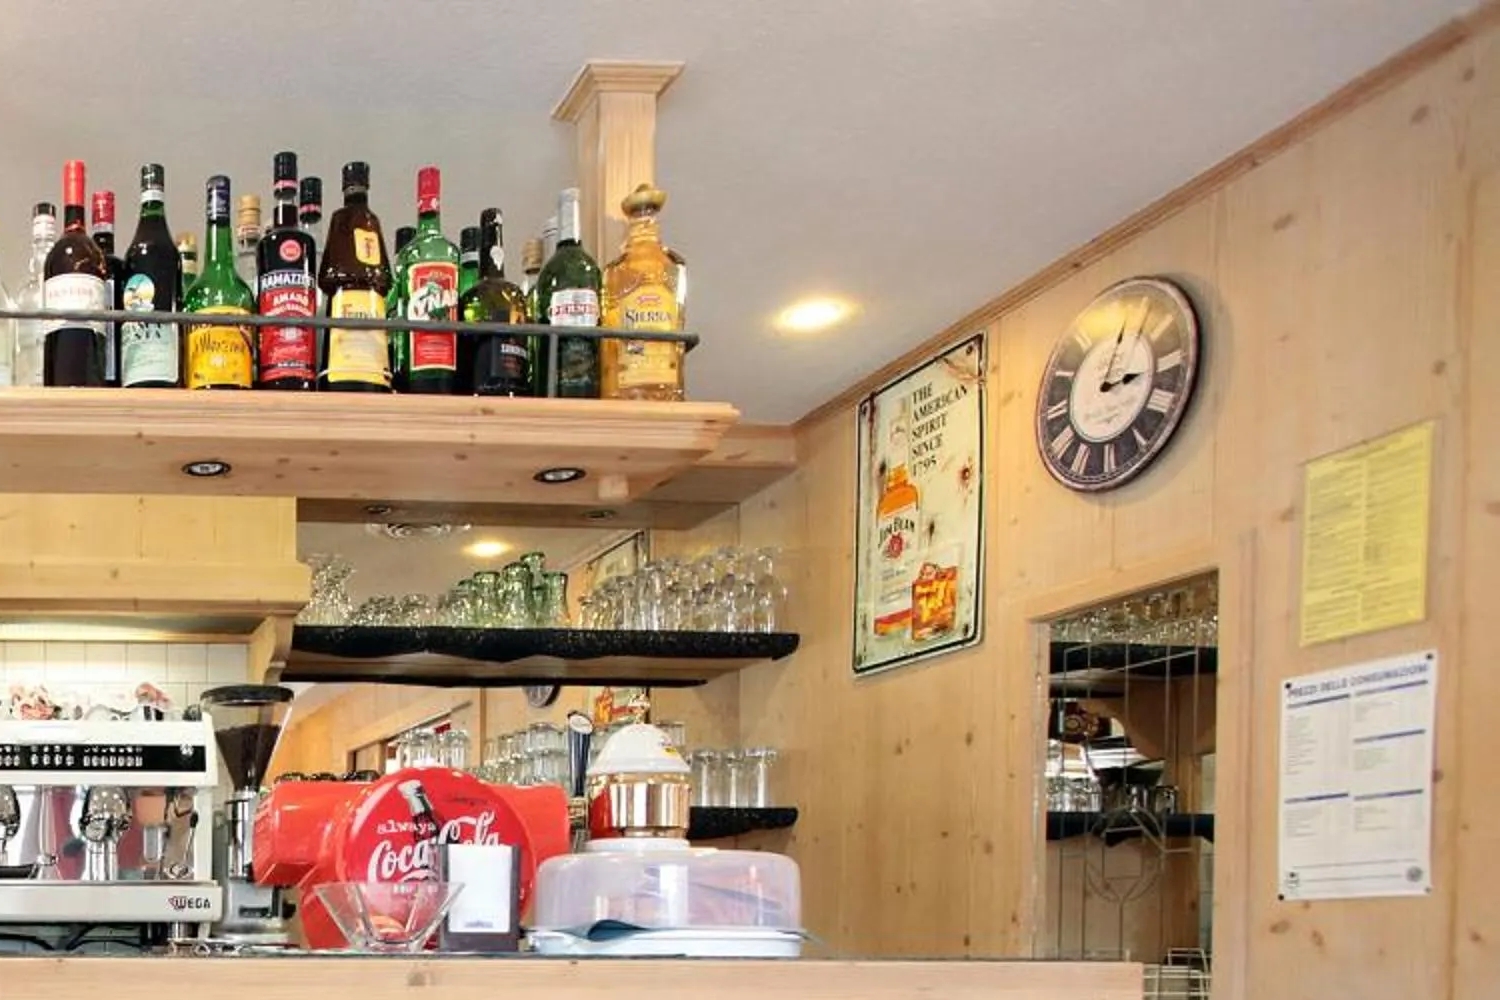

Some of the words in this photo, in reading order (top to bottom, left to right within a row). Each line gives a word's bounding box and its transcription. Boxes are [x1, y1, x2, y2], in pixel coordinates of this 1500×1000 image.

[912, 382, 933, 404] THE
[913, 384, 968, 421] AMERICAN
[912, 412, 947, 438] SPIRIT
[912, 432, 942, 456] SINCE
[377, 819, 437, 835] always
[173, 898, 211, 909] WEGA
